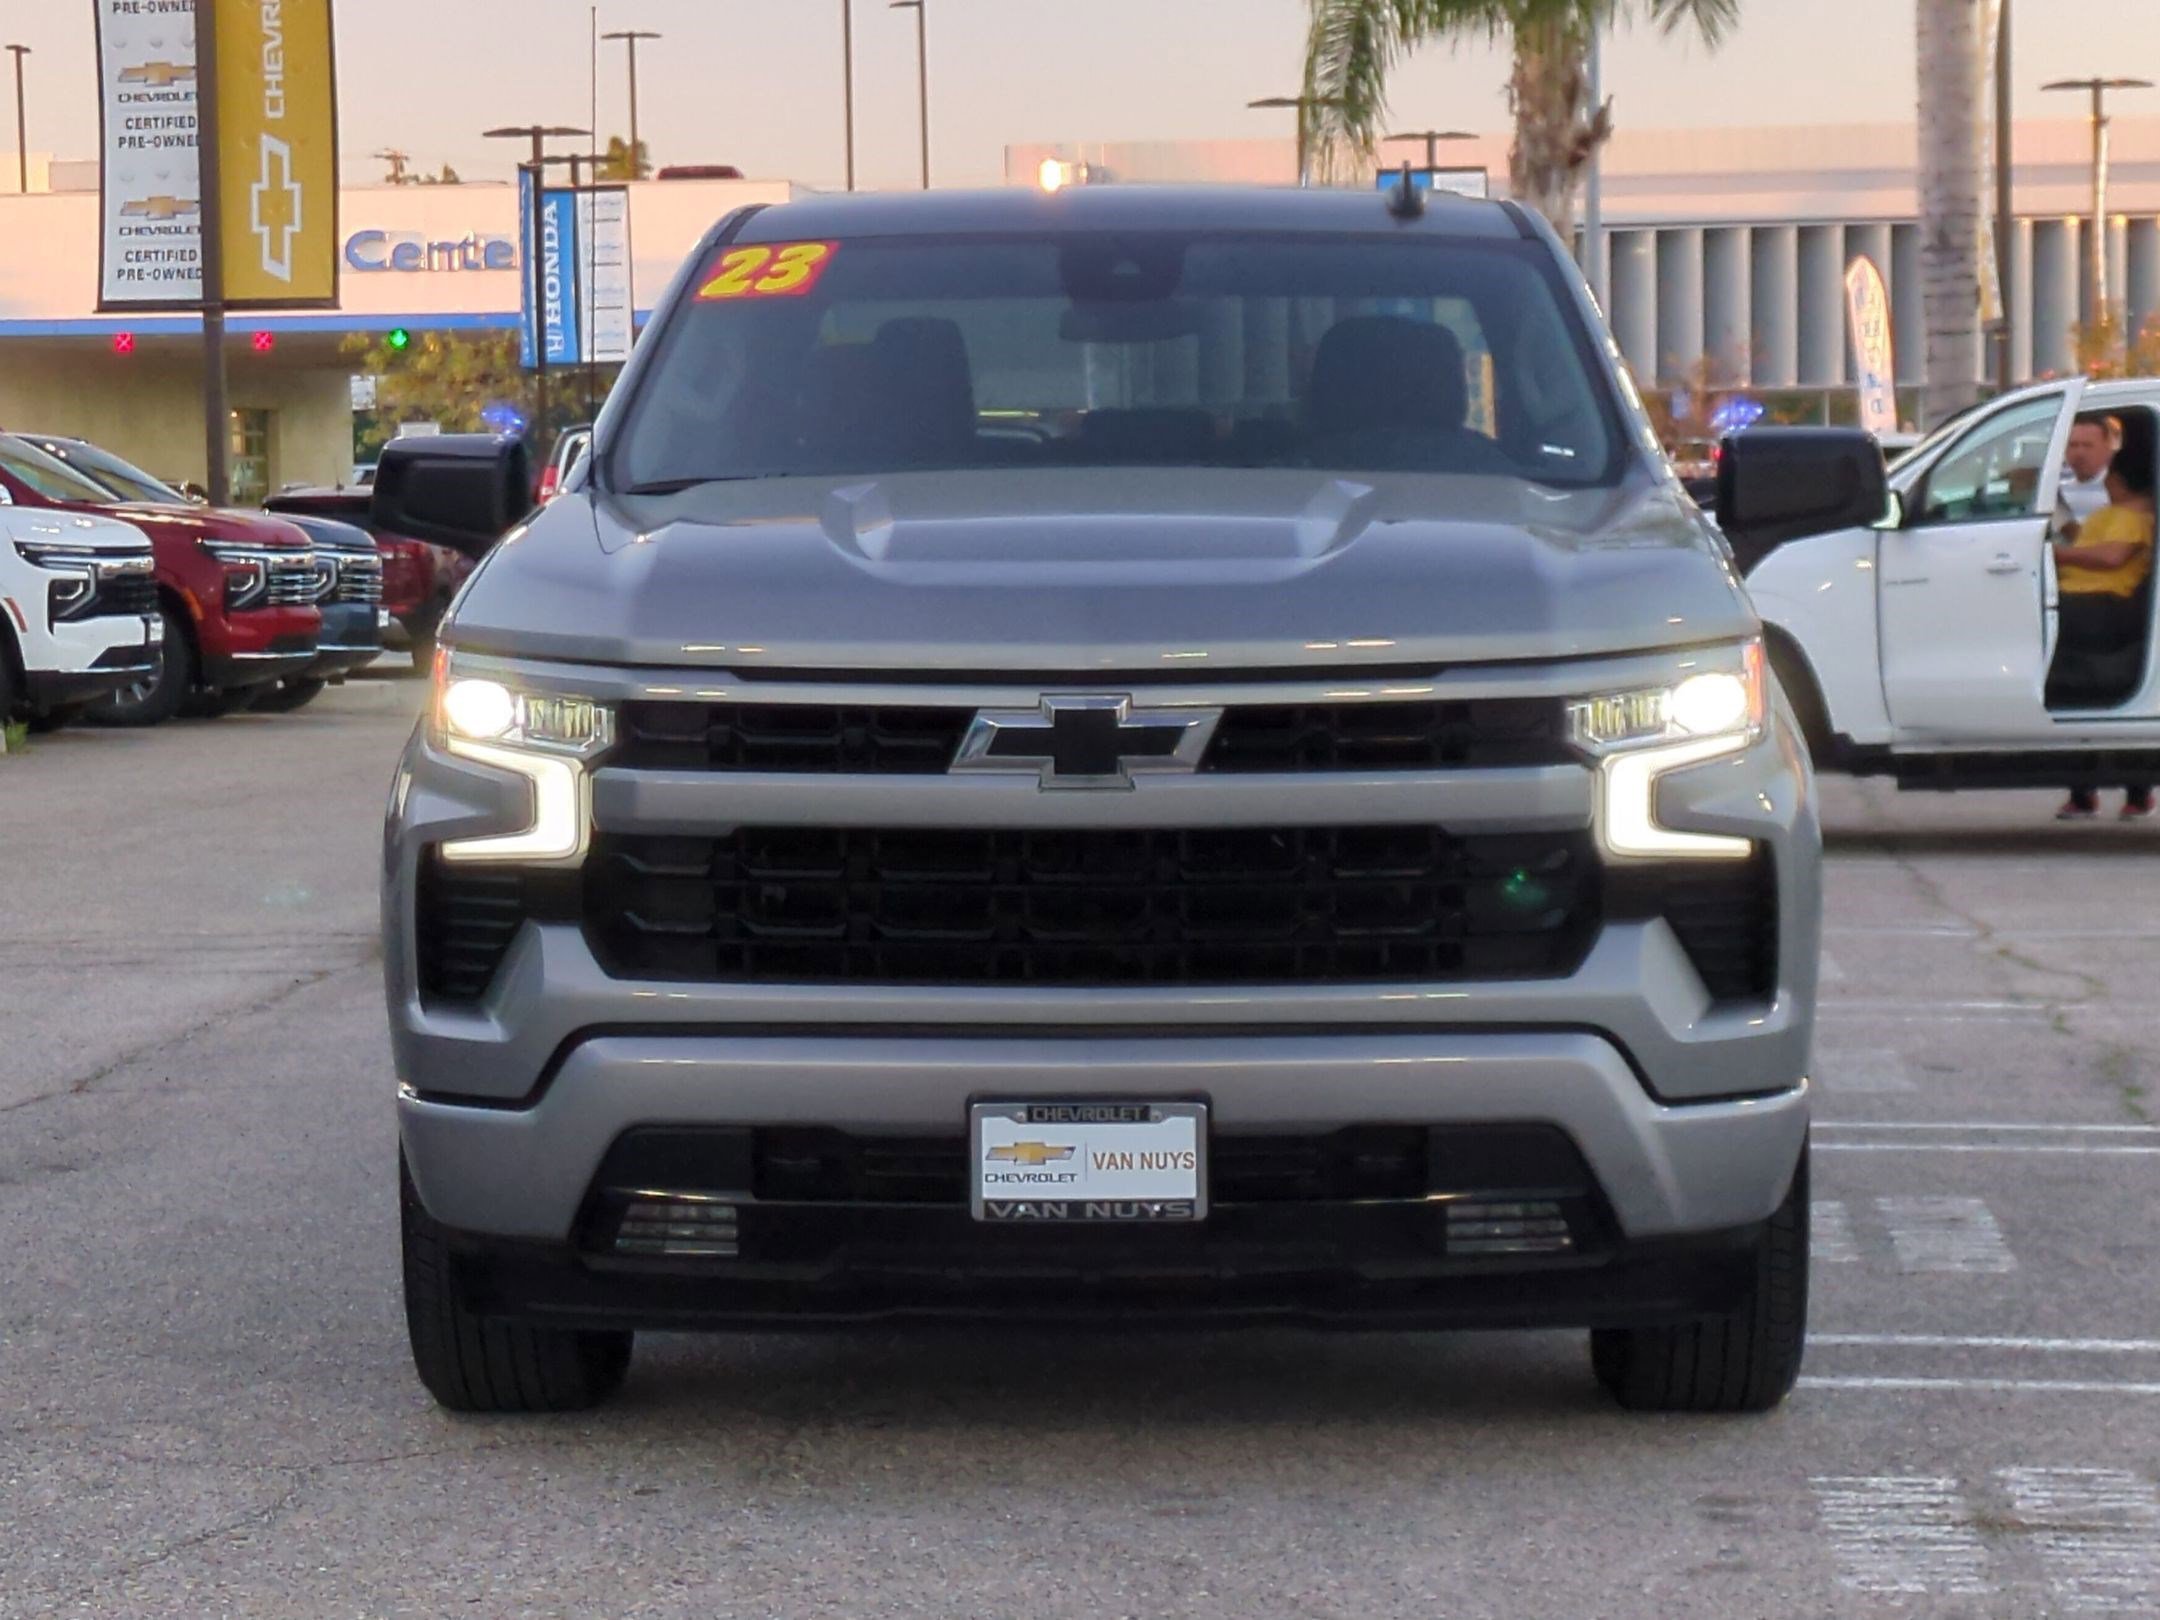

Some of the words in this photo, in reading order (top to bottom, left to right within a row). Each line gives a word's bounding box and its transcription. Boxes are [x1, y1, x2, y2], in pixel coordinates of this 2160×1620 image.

[261, 0, 285, 119] CHEVR
[118, 91, 199, 103] CHEVROLE
[125, 116, 196, 130] CERTIFIED
[119, 225, 201, 236] CHEVROLE
[125, 249, 198, 263] CERTIFIED
[345, 229, 517, 272] Cente
[542, 200, 562, 326] HONDA
[699, 243, 828, 297] 23
[1032, 1106, 1143, 1122] CHEVROLET
[1092, 1151, 1134, 1170] VAN
[1140, 1151, 1196, 1170] NUYS
[984, 1173, 1078, 1184] CHEVROLET
[986, 1201, 1069, 1219] VAN
[1085, 1201, 1194, 1219] NUYS
